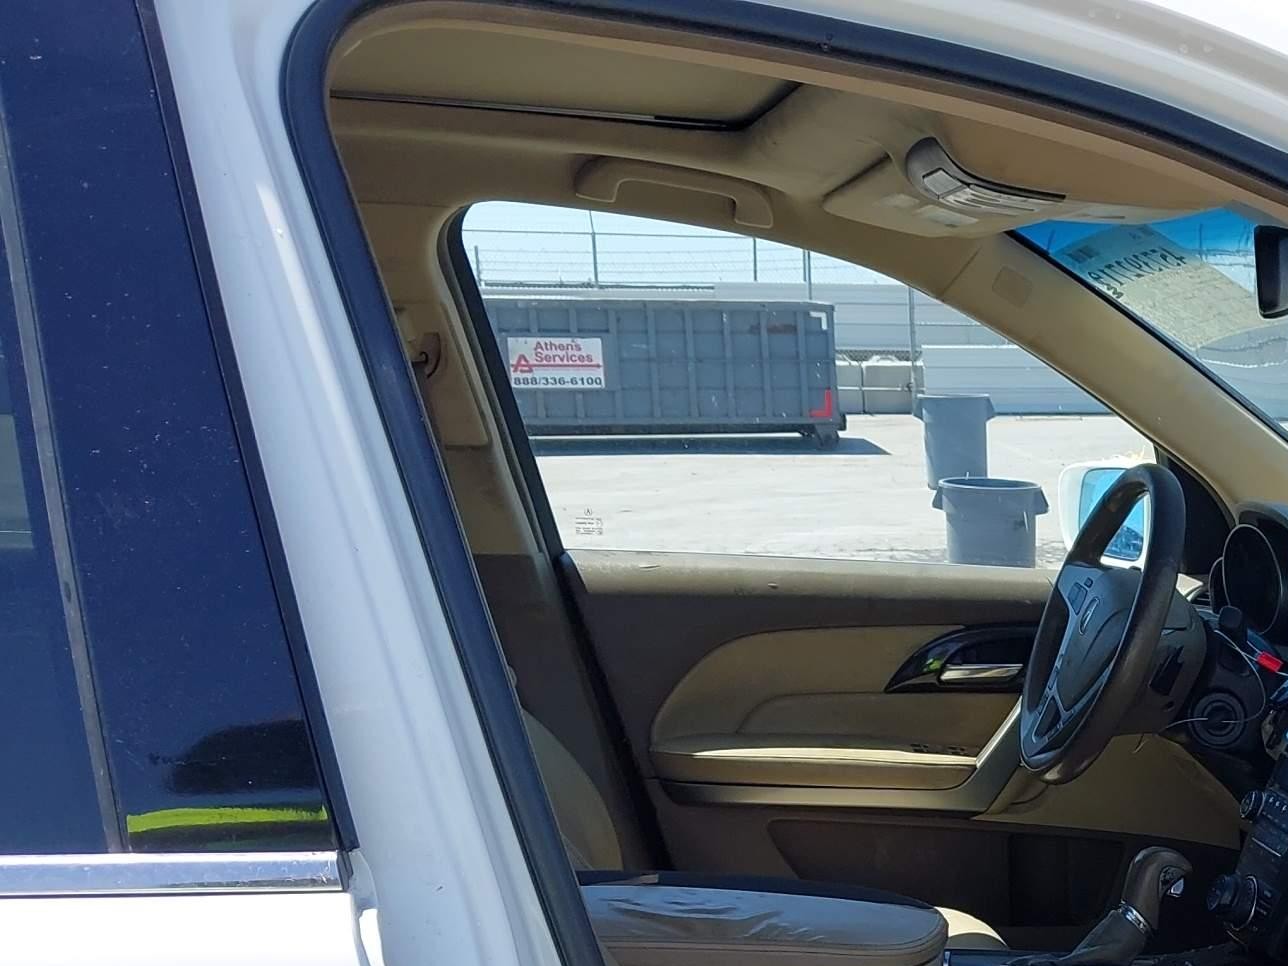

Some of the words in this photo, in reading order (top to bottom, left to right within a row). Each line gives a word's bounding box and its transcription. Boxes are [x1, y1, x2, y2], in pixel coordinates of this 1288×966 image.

[534, 341, 582, 351] Athens
[534, 352, 593, 363] Services
[513, 377, 602, 386] 888/336-6100
